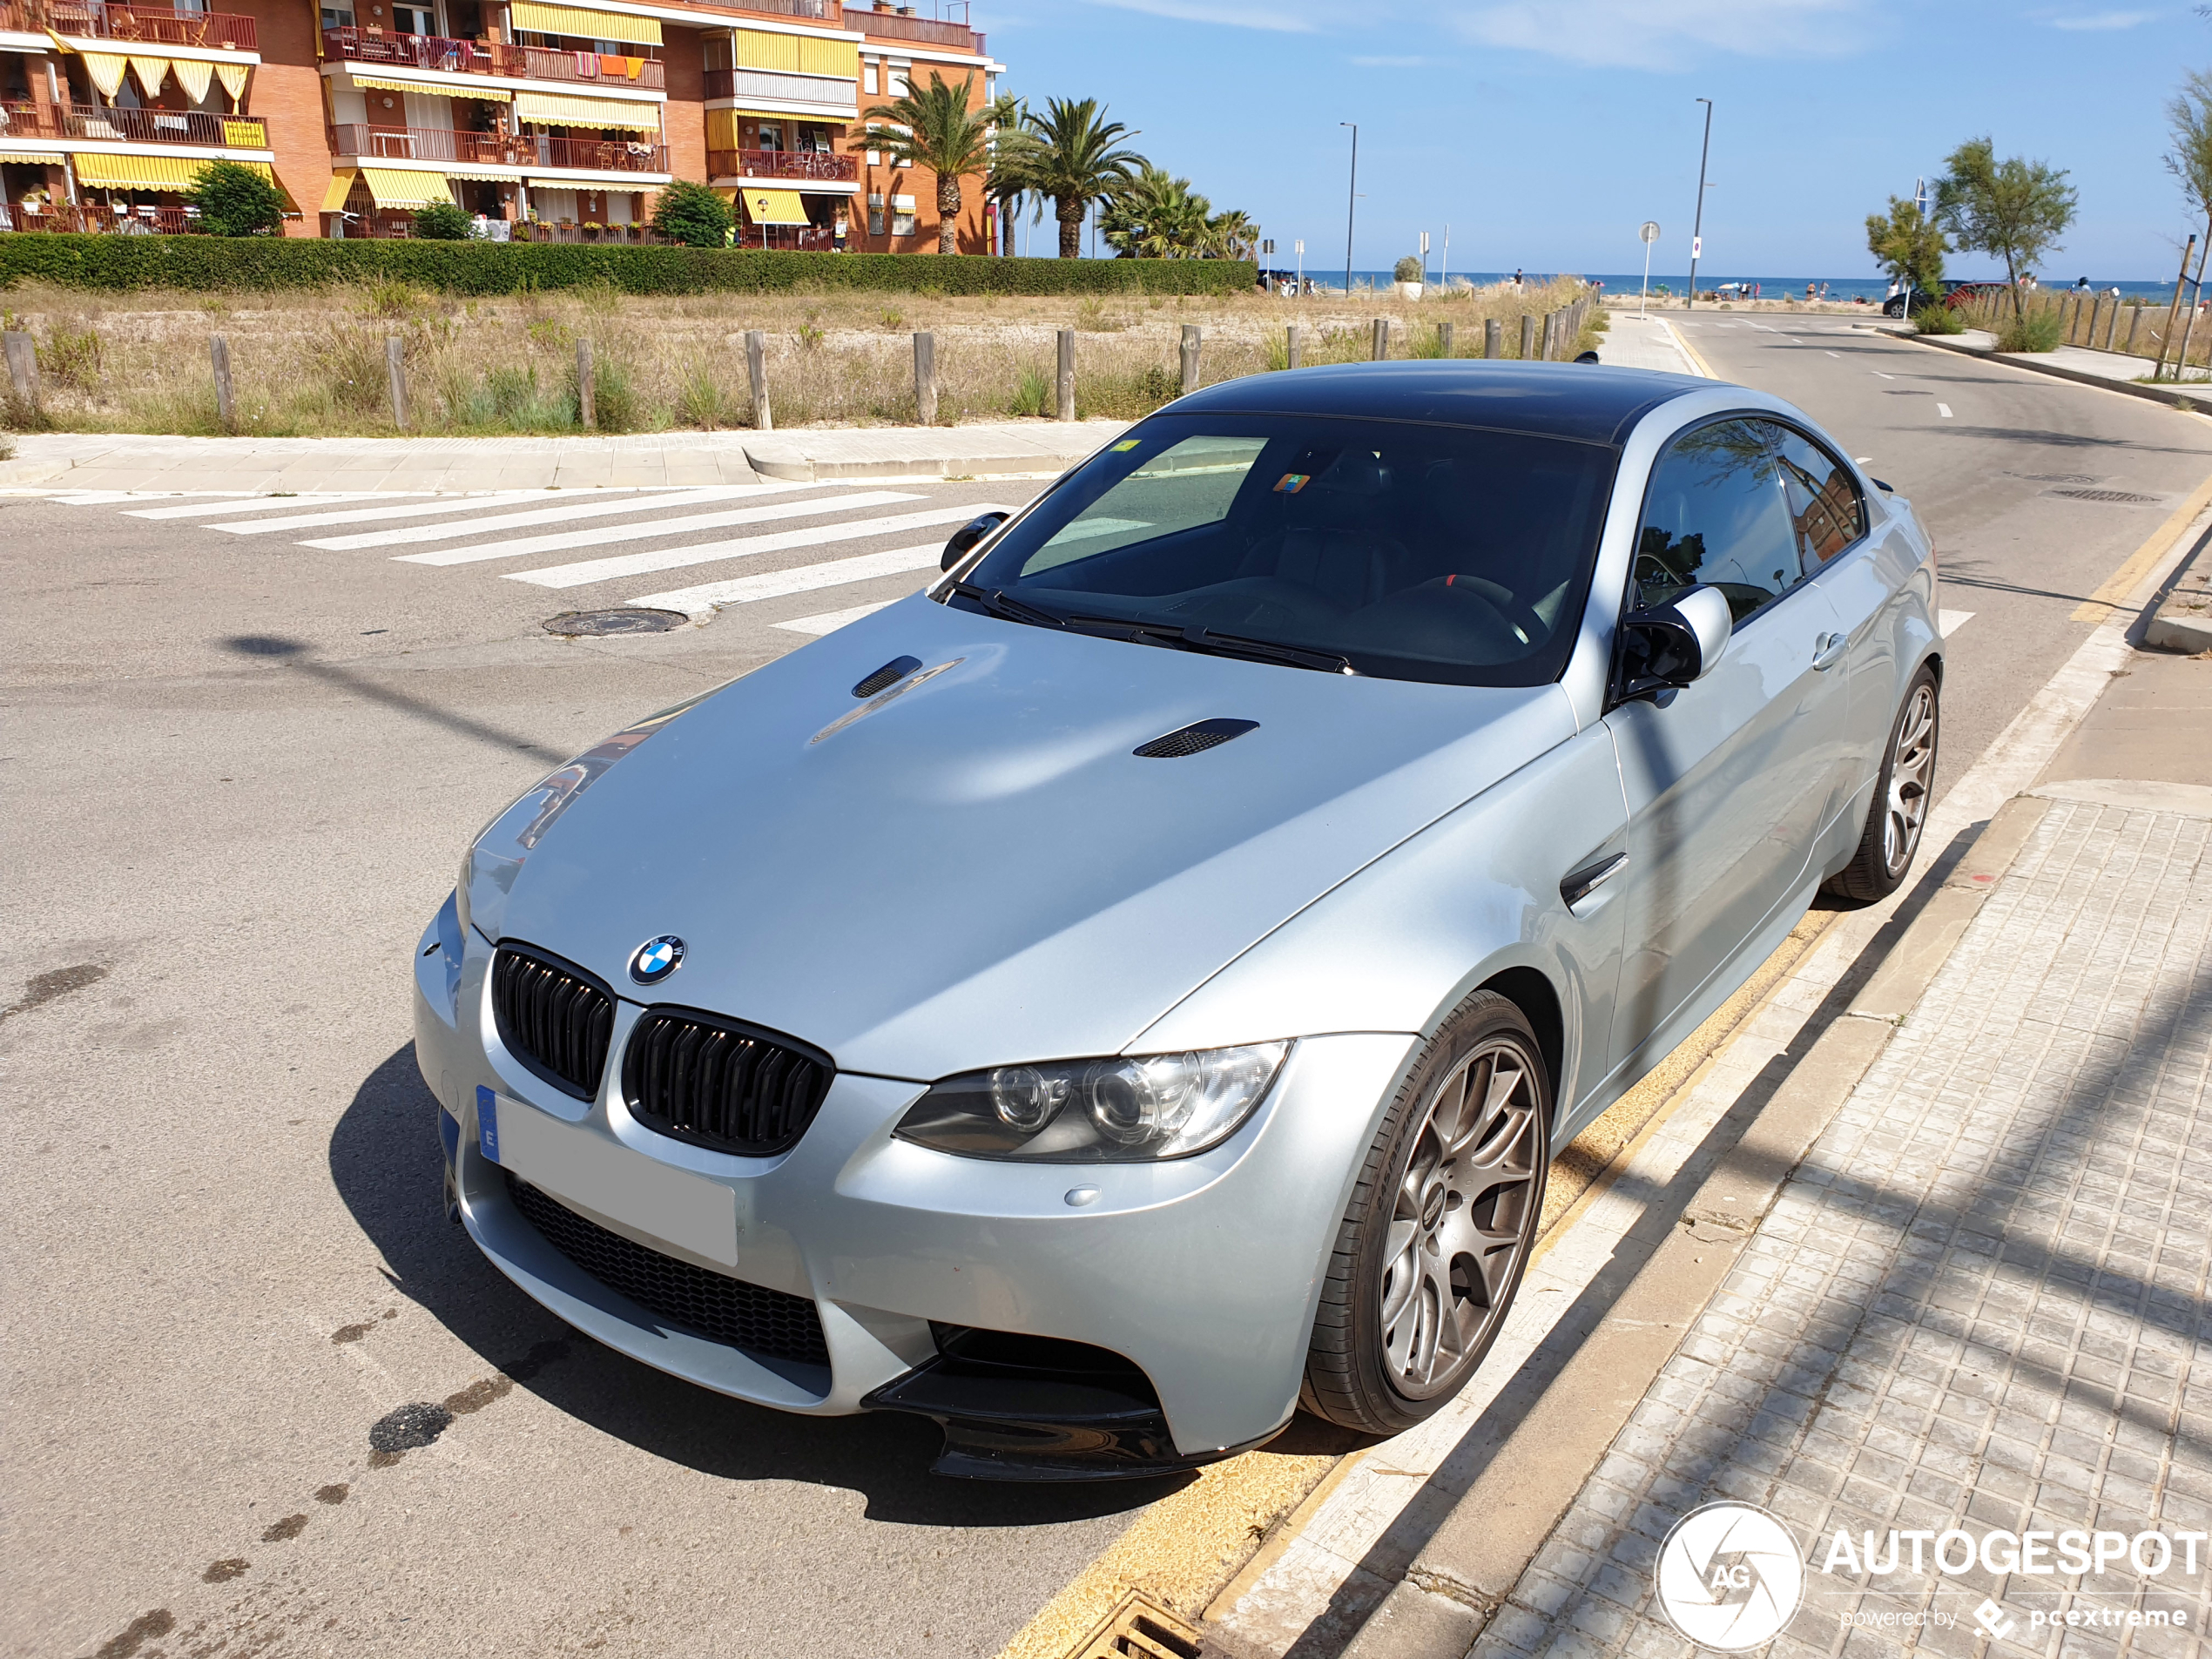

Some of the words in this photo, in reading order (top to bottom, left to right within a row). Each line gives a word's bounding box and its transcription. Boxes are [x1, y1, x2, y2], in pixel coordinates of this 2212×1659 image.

[650, 936, 684, 955] BMW
[486, 1130, 495, 1146] E
[1377, 1140, 1401, 1211] 245/35
[1401, 1092, 1421, 1138] ZR19
[1424, 1188, 1443, 1225] BBS
